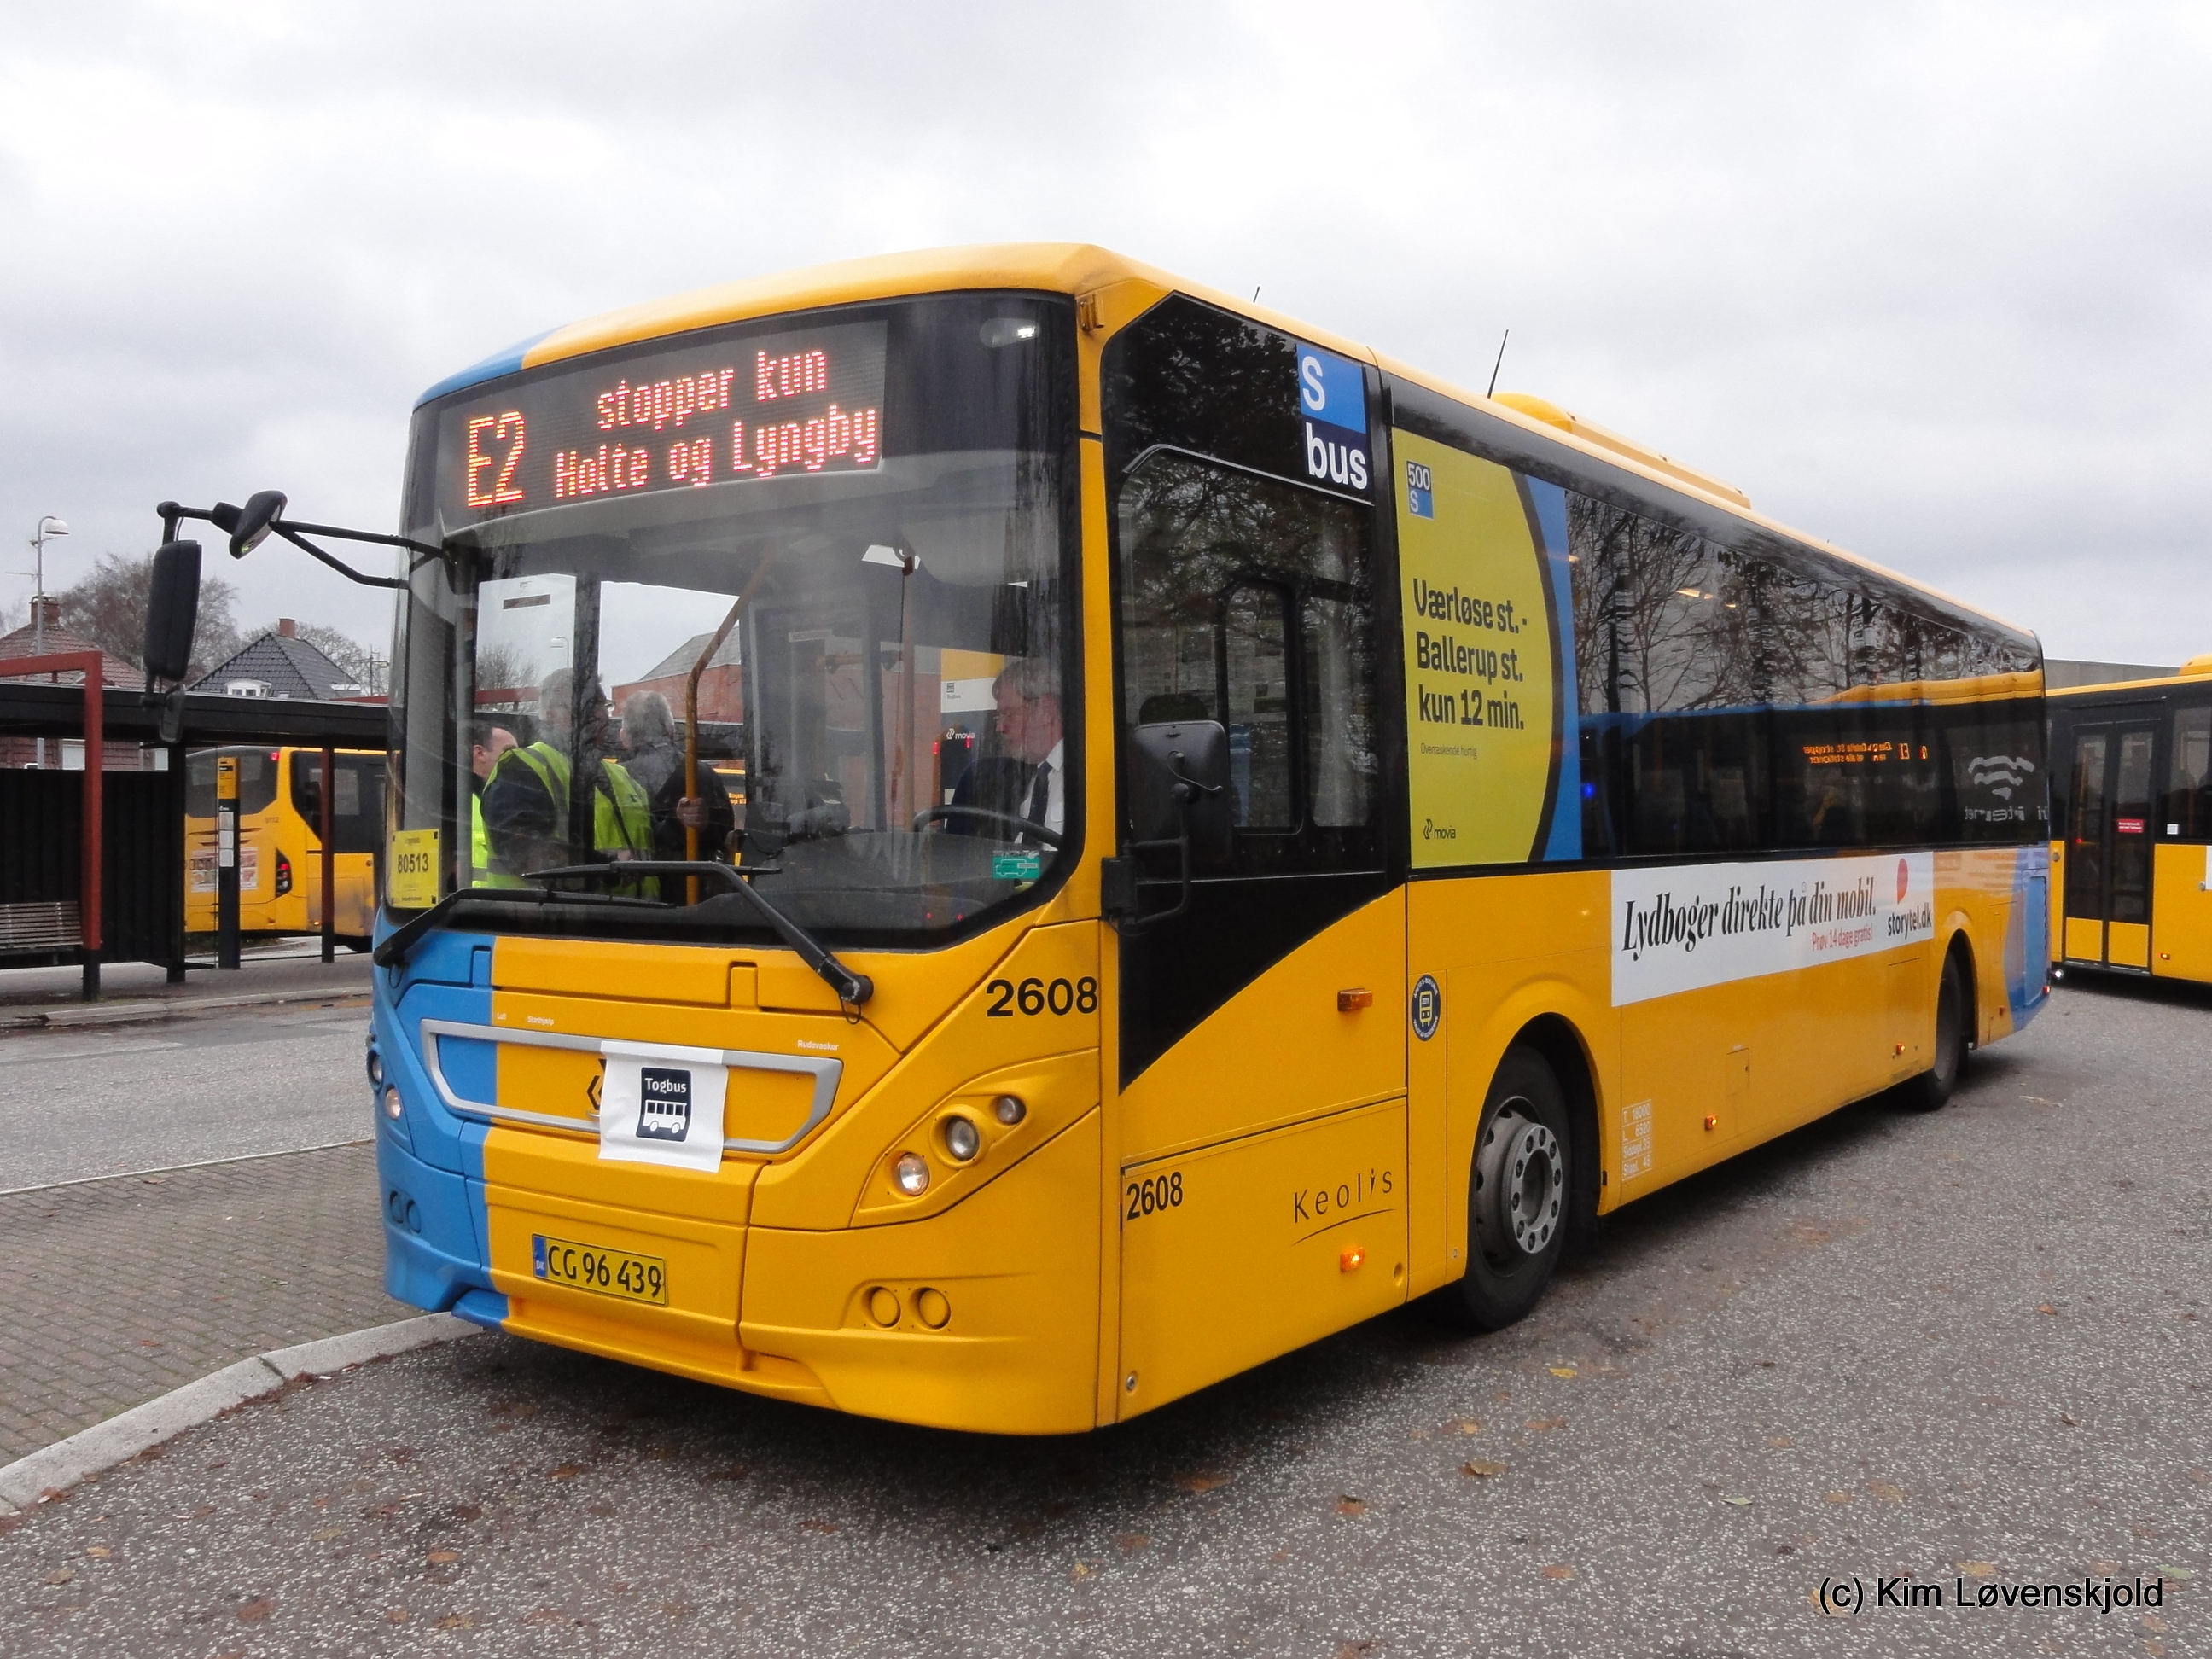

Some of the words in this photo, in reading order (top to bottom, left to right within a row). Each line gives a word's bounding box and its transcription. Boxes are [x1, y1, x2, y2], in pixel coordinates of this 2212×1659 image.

[597, 369, 735, 430] stopper
[757, 350, 826, 402] kun
[1301, 355, 1327, 411] S
[468, 411, 525, 506] E2
[556, 443, 649, 498] Holte
[669, 438, 711, 487] og
[733, 405, 877, 479] Lyngby
[1305, 422, 1367, 490] bus
[1407, 463, 1430, 491] 500
[1410, 490, 1418, 513] S
[1412, 578, 1493, 629] Værløse
[1417, 631, 1498, 686] Ballerup
[1501, 649, 1523, 682] st.
[1418, 684, 1455, 725] kun
[1460, 690, 1483, 725] 12
[1487, 692, 1524, 731] min.
[1434, 824, 1456, 841] movia
[398, 853, 428, 874] 80513
[1621, 891, 1719, 962] Lydbøger
[1720, 884, 1784, 935] direkte
[1786, 881, 1807, 937] på
[1808, 880, 1833, 926] din
[1836, 876, 1876, 921] mobil.
[1811, 931, 1828, 952] Prøv
[1828, 929, 1837, 948] 14
[1837, 928, 1853, 949] dage
[1853, 923, 1873, 948] gratis!
[1887, 902, 1932, 940] storytel.dk
[986, 976, 1099, 1017] 2608
[797, 1039, 839, 1051] Rudevasker
[644, 1077, 687, 1095] Togbus
[1126, 1171, 1184, 1220] 2608
[1293, 1167, 1394, 1224] Keolis
[535, 1260, 545, 1271] DK
[547, 1244, 578, 1280] CG
[582, 1251, 611, 1286] 96
[616, 1260, 662, 1298] 439
